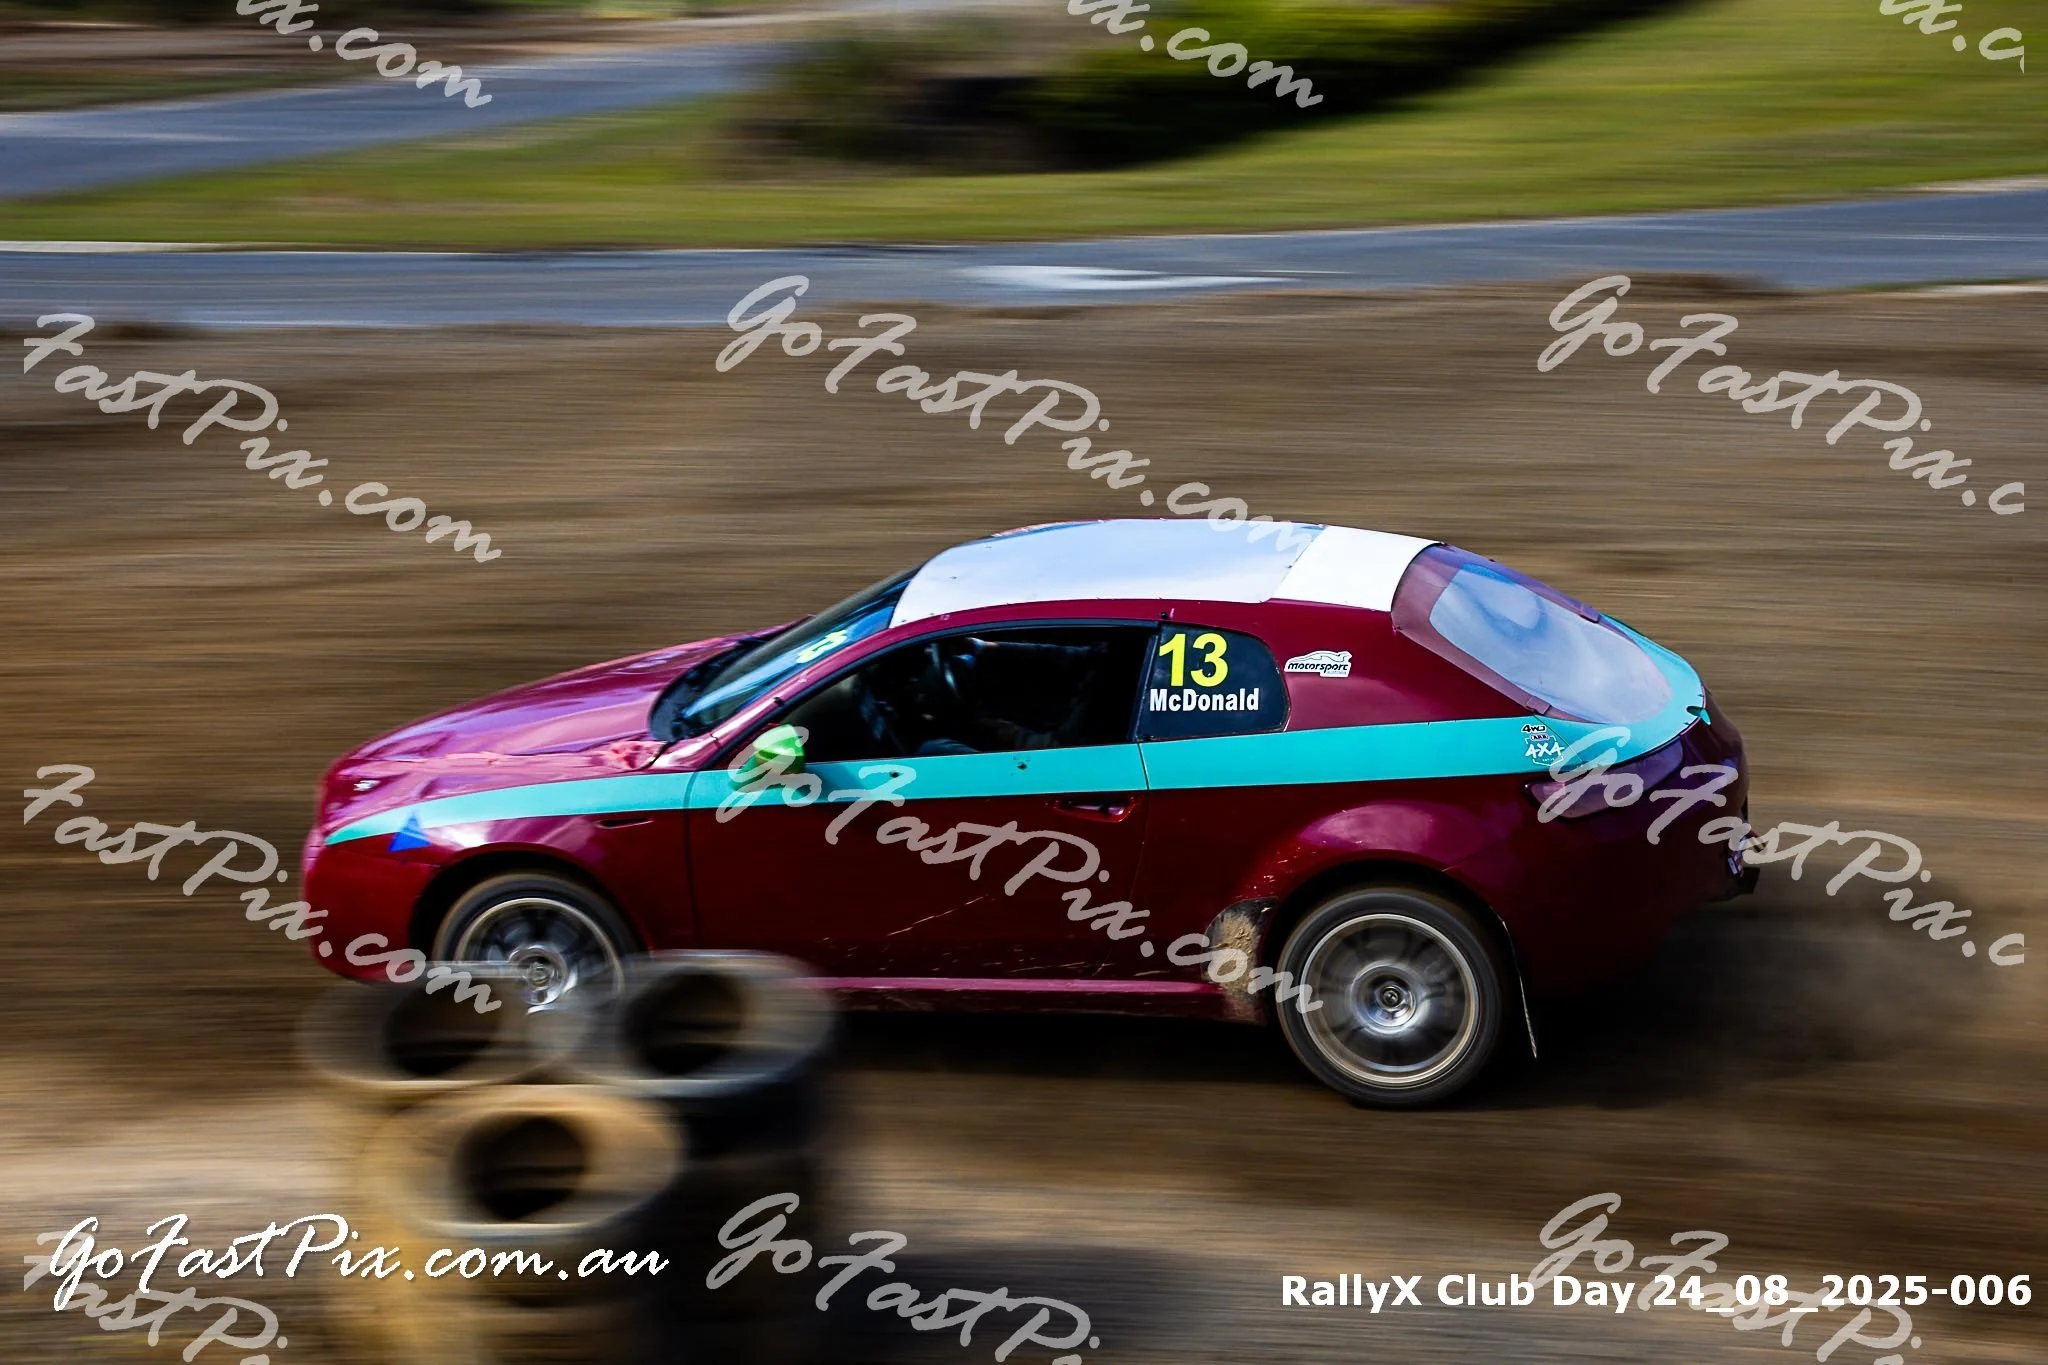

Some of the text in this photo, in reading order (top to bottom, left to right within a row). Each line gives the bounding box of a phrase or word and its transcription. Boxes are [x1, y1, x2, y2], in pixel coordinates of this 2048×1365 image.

[1159, 632, 1229, 687] 13
[1287, 662, 1349, 674] motorsport
[1149, 687, 1260, 712] McDonald
